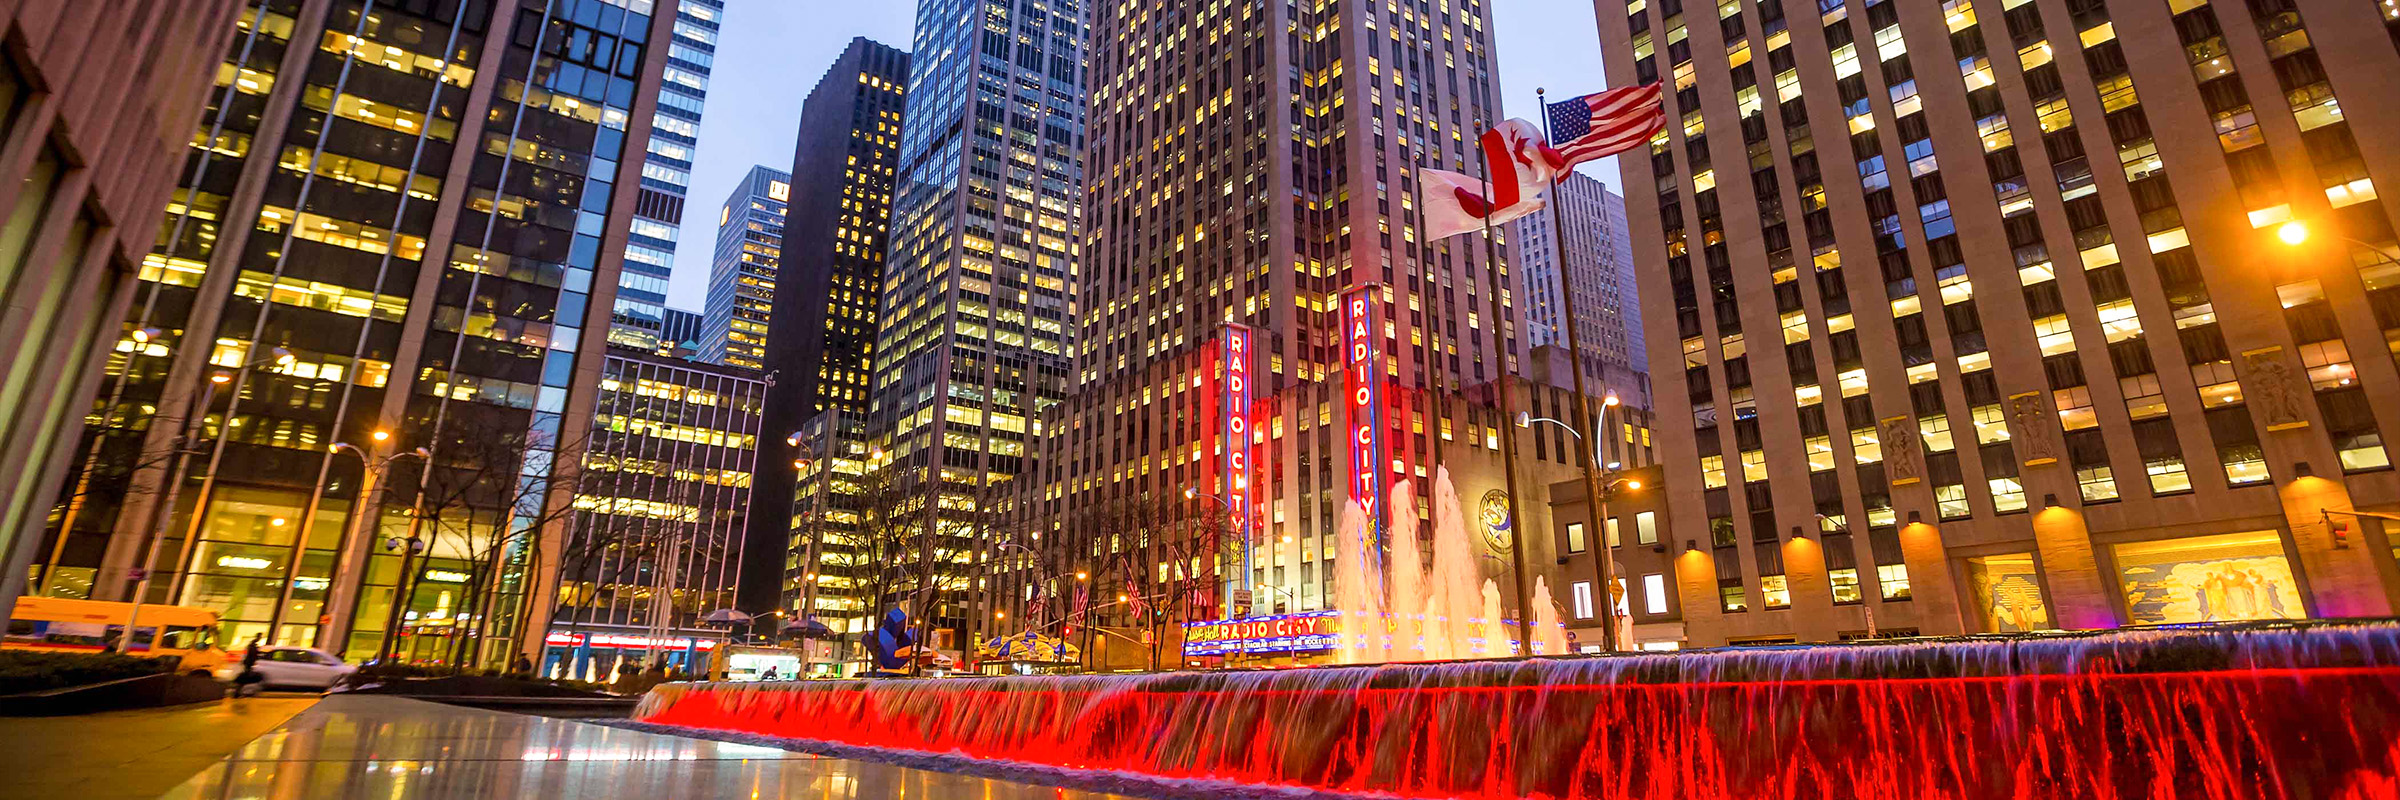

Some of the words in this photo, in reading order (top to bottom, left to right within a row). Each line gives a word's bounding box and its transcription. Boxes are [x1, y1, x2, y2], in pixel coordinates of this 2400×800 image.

[1230, 335, 1245, 434] RADIO
[1353, 298, 1371, 406] RADIO
[1230, 451, 1245, 534] CITY
[1358, 425, 1375, 516] CITY
[1202, 624, 1220, 642] Hall
[1220, 621, 1268, 639] RADIO
